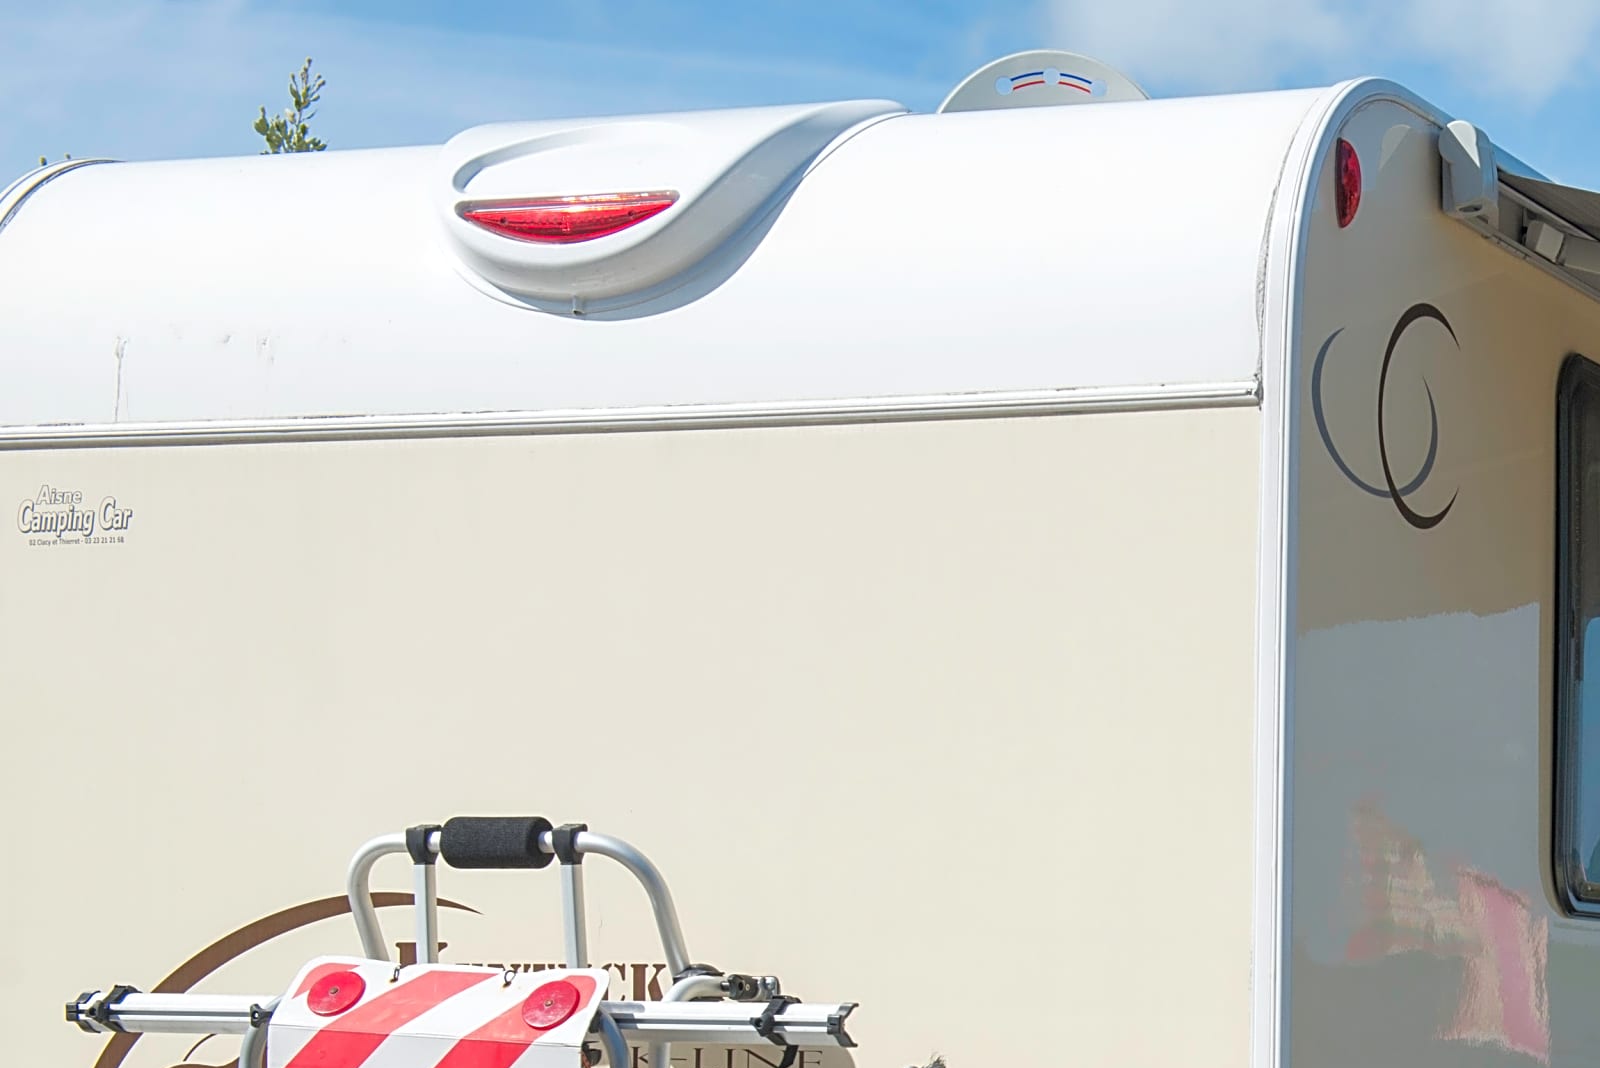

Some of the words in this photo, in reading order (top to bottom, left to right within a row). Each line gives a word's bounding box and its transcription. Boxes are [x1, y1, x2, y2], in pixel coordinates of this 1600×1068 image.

[35, 484, 83, 505] Aisne
[17, 498, 95, 537] Camping
[99, 495, 133, 531] Car
[84, 537, 93, 545] 03
[93, 537, 100, 545] 23
[101, 536, 108, 544] 21
[109, 536, 116, 544] 21
